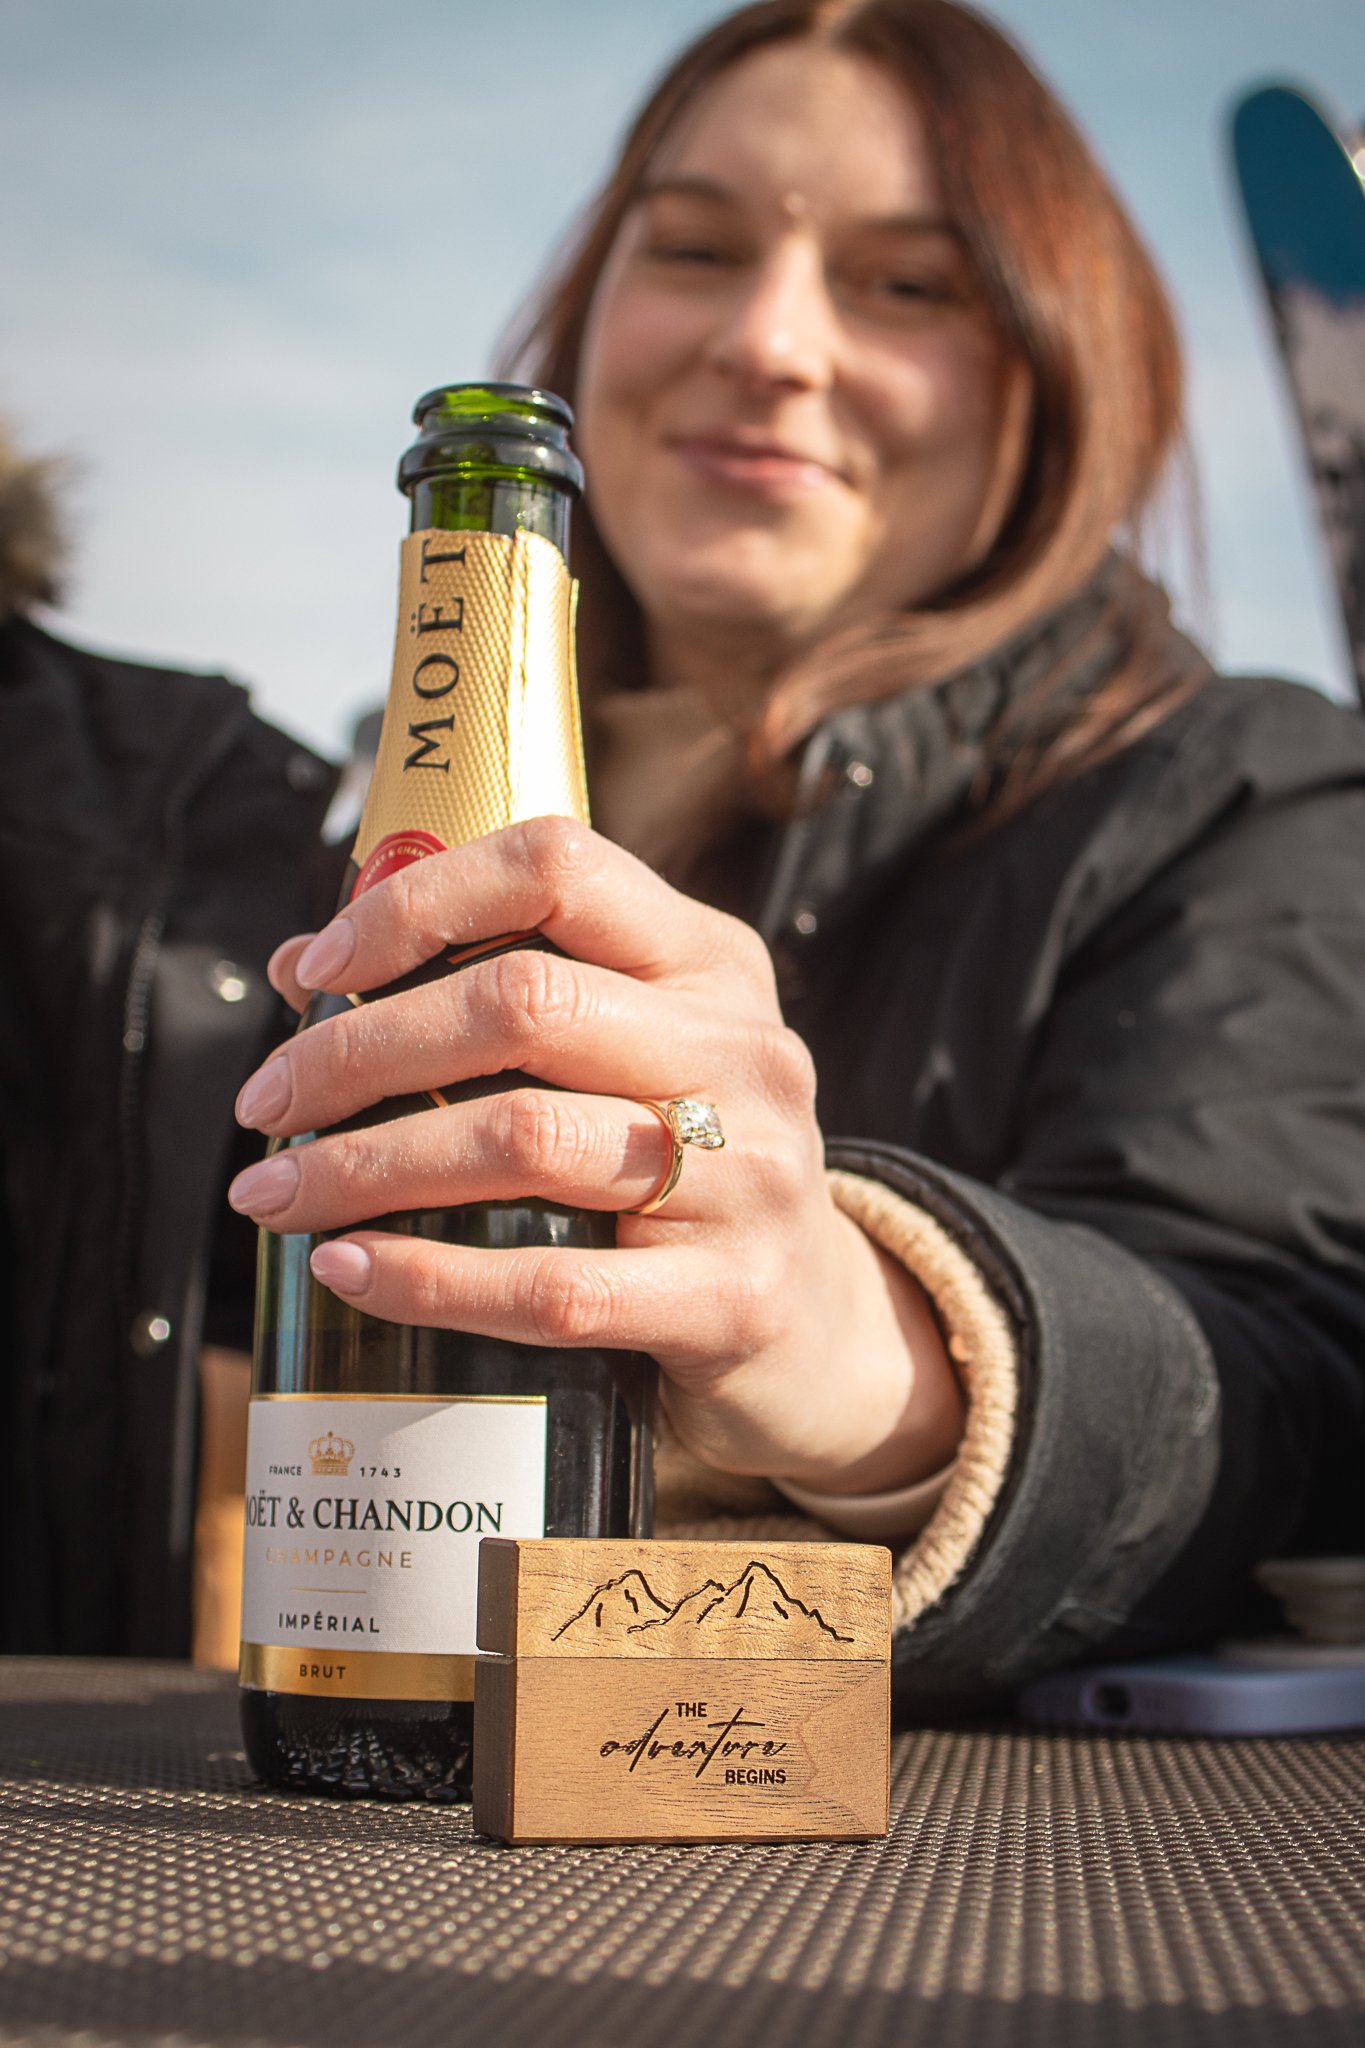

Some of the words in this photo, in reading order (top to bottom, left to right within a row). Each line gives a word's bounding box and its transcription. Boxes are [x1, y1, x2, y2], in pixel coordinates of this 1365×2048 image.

[403, 538, 467, 773] MOËT
[397, 845, 427, 860] CHAN
[269, 1465, 302, 1477] FRANCE
[359, 1466, 402, 1479] 1743
[286, 1496, 305, 1529] &
[313, 1498, 503, 1533] CHANDON
[265, 1546, 412, 1570] CHAMPAGNE
[278, 1611, 380, 1633] IMPÉRIAL
[300, 1664, 346, 1680] BRUT
[675, 1702, 707, 1718] THE
[600, 1707, 787, 1778] adventure
[725, 1769, 787, 1785] BEGINS
